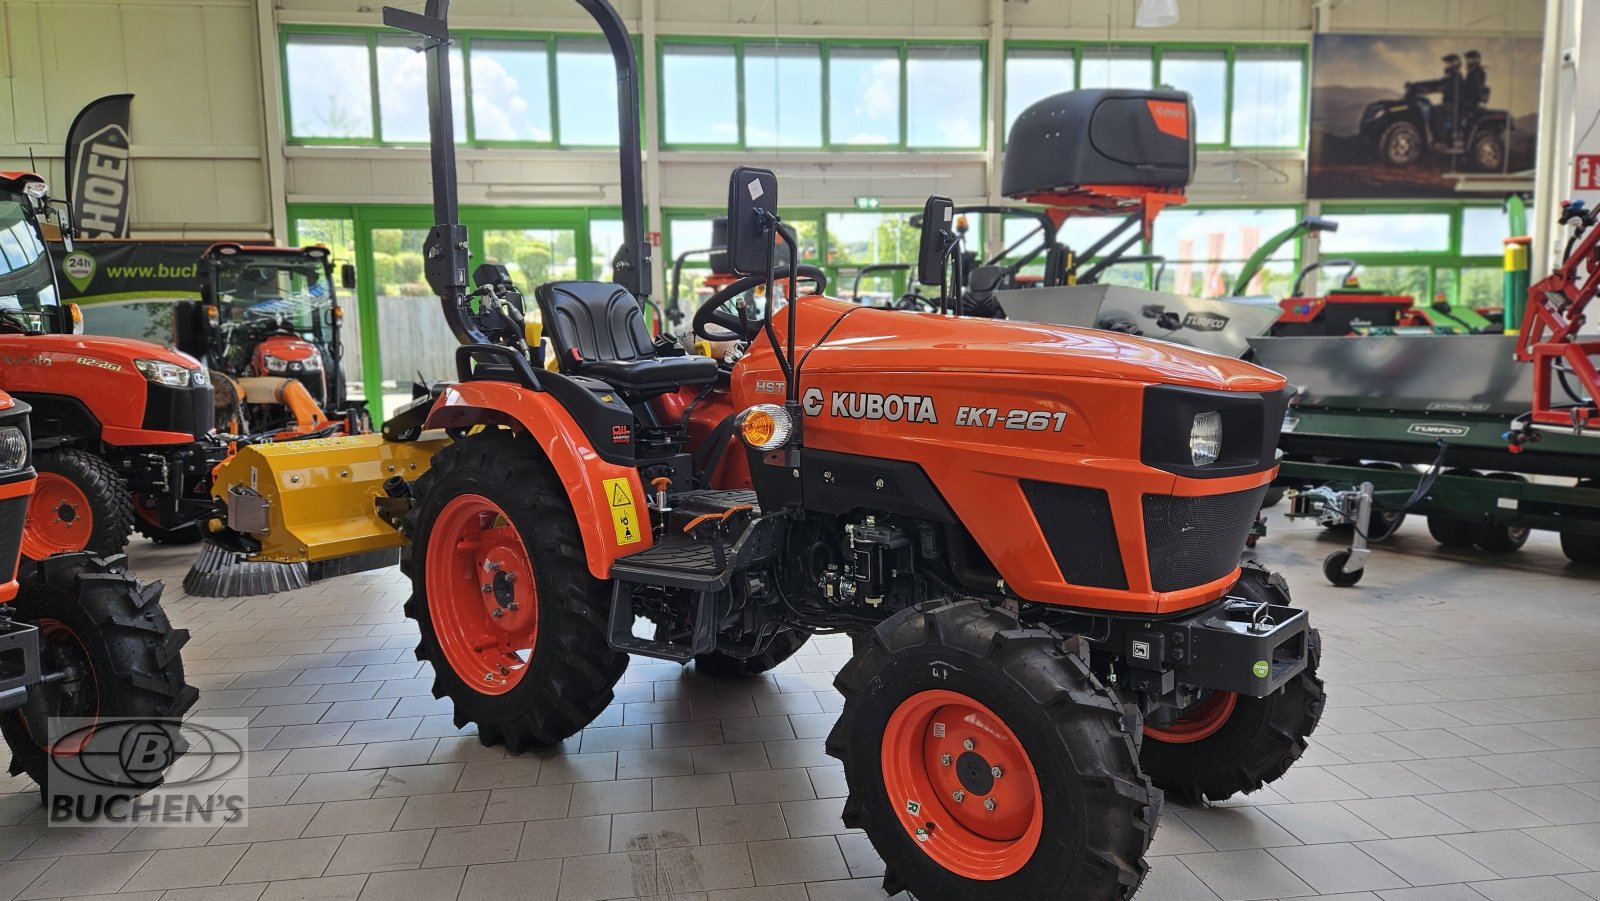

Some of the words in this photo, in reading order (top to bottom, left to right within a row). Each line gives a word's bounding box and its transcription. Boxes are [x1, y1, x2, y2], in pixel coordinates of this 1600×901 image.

[68, 258, 91, 268] 24h
[1186, 315, 1225, 328] TURFCO
[755, 380, 785, 393] HST
[830, 391, 938, 424] KUBOTA
[954, 405, 1067, 432] EK1-261
[1413, 425, 1463, 434] TURFCO
